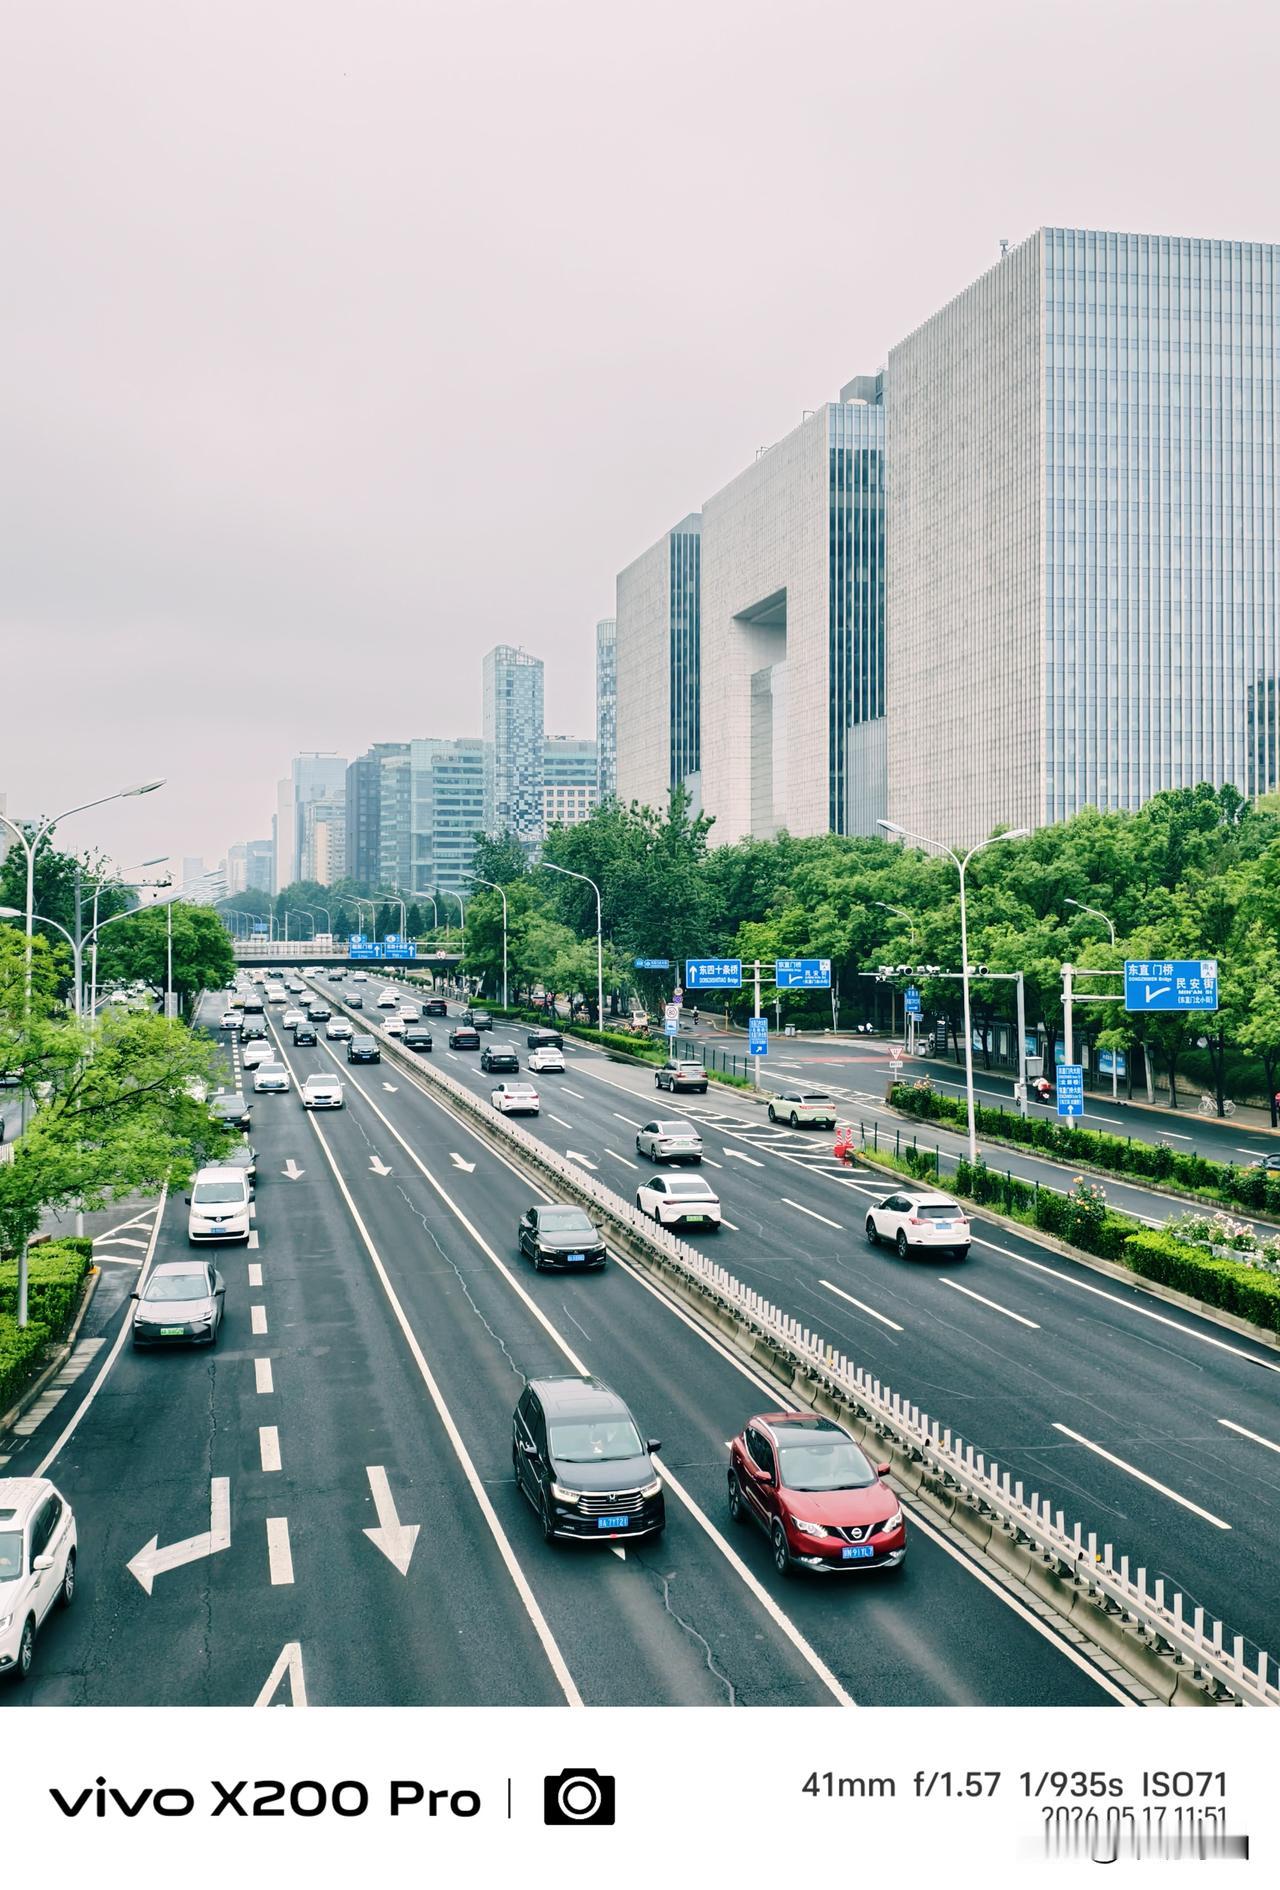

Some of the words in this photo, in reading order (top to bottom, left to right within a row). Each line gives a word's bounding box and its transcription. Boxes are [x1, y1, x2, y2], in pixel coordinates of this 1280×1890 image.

[699, 964, 738, 975] 东四十条桥
[1128, 963, 1174, 976] 东直门桥
[1176, 977, 1214, 989] 民安街
